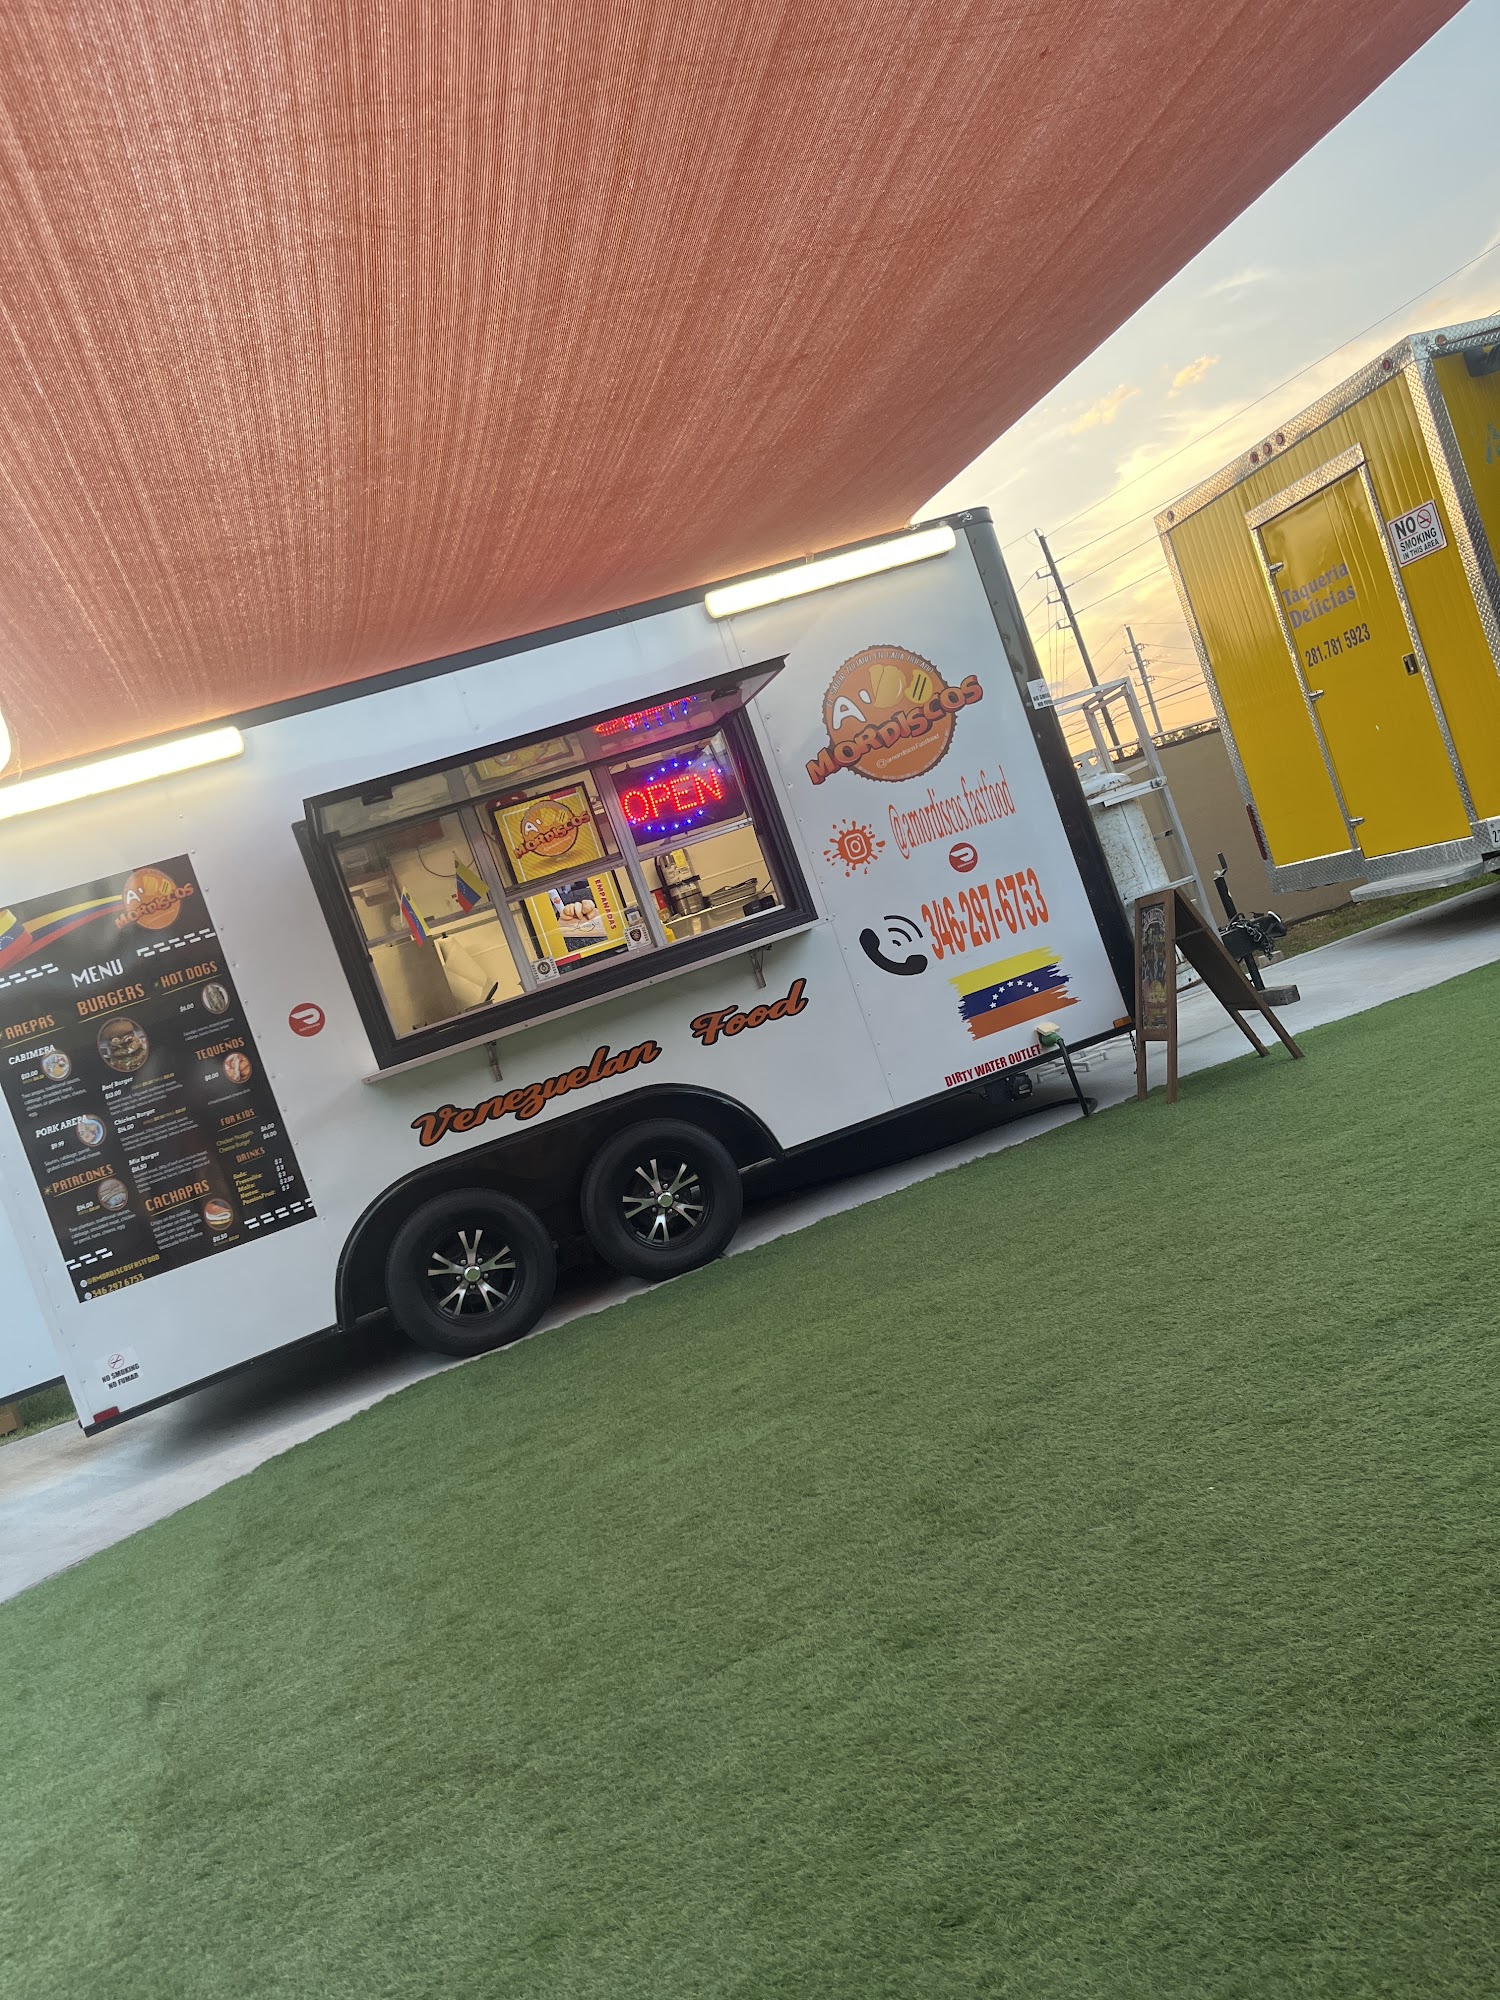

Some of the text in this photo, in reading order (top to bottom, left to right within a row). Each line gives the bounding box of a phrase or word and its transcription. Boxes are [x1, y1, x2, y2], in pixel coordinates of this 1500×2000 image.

[1394, 517, 1416, 539] NO
[1400, 528, 1437, 551] SMOKING
[1410, 546, 1423, 557] THIS
[1425, 539, 1439, 550] AREA
[1289, 585, 1356, 629] Delicias
[1305, 623, 1370, 667] 281.781 5923
[805, 674, 983, 786] MORDISCOS
[622, 768, 723, 821] OPEN
[888, 764, 1016, 859] @amordiscos.fastfood
[514, 811, 590, 859] MORDISCOS
[115, 881, 195, 929] MORDISCOS
[595, 879, 617, 930] EMPANADAS
[921, 867, 1049, 960] 346-297-6753
[71, 958, 124, 988] MENU
[160, 960, 217, 988] HOT DOGS
[77, 983, 144, 1015] BURGERS
[4, 1014, 54, 1040] AREPAS
[8, 1044, 55, 1065] CABIMERA
[411, 977, 808, 1147] Venezuelan Food
[944, 1044, 1041, 1087] DIRTY WATER OUTLET
[114, 1076, 134, 1088] Burger
[35, 1114, 87, 1138] PORK AREPA
[220, 1108, 254, 1126] FOR KIDS
[236, 1146, 265, 1163] DRINKS
[52, 1164, 113, 1193] PATACONES
[144, 1179, 209, 1211] CACHAPAS
[91, 1272, 144, 1298] 346 297 6753
[102, 1363, 140, 1383] NO SMOKING
[108, 1372, 139, 1389] NO FUMAR
